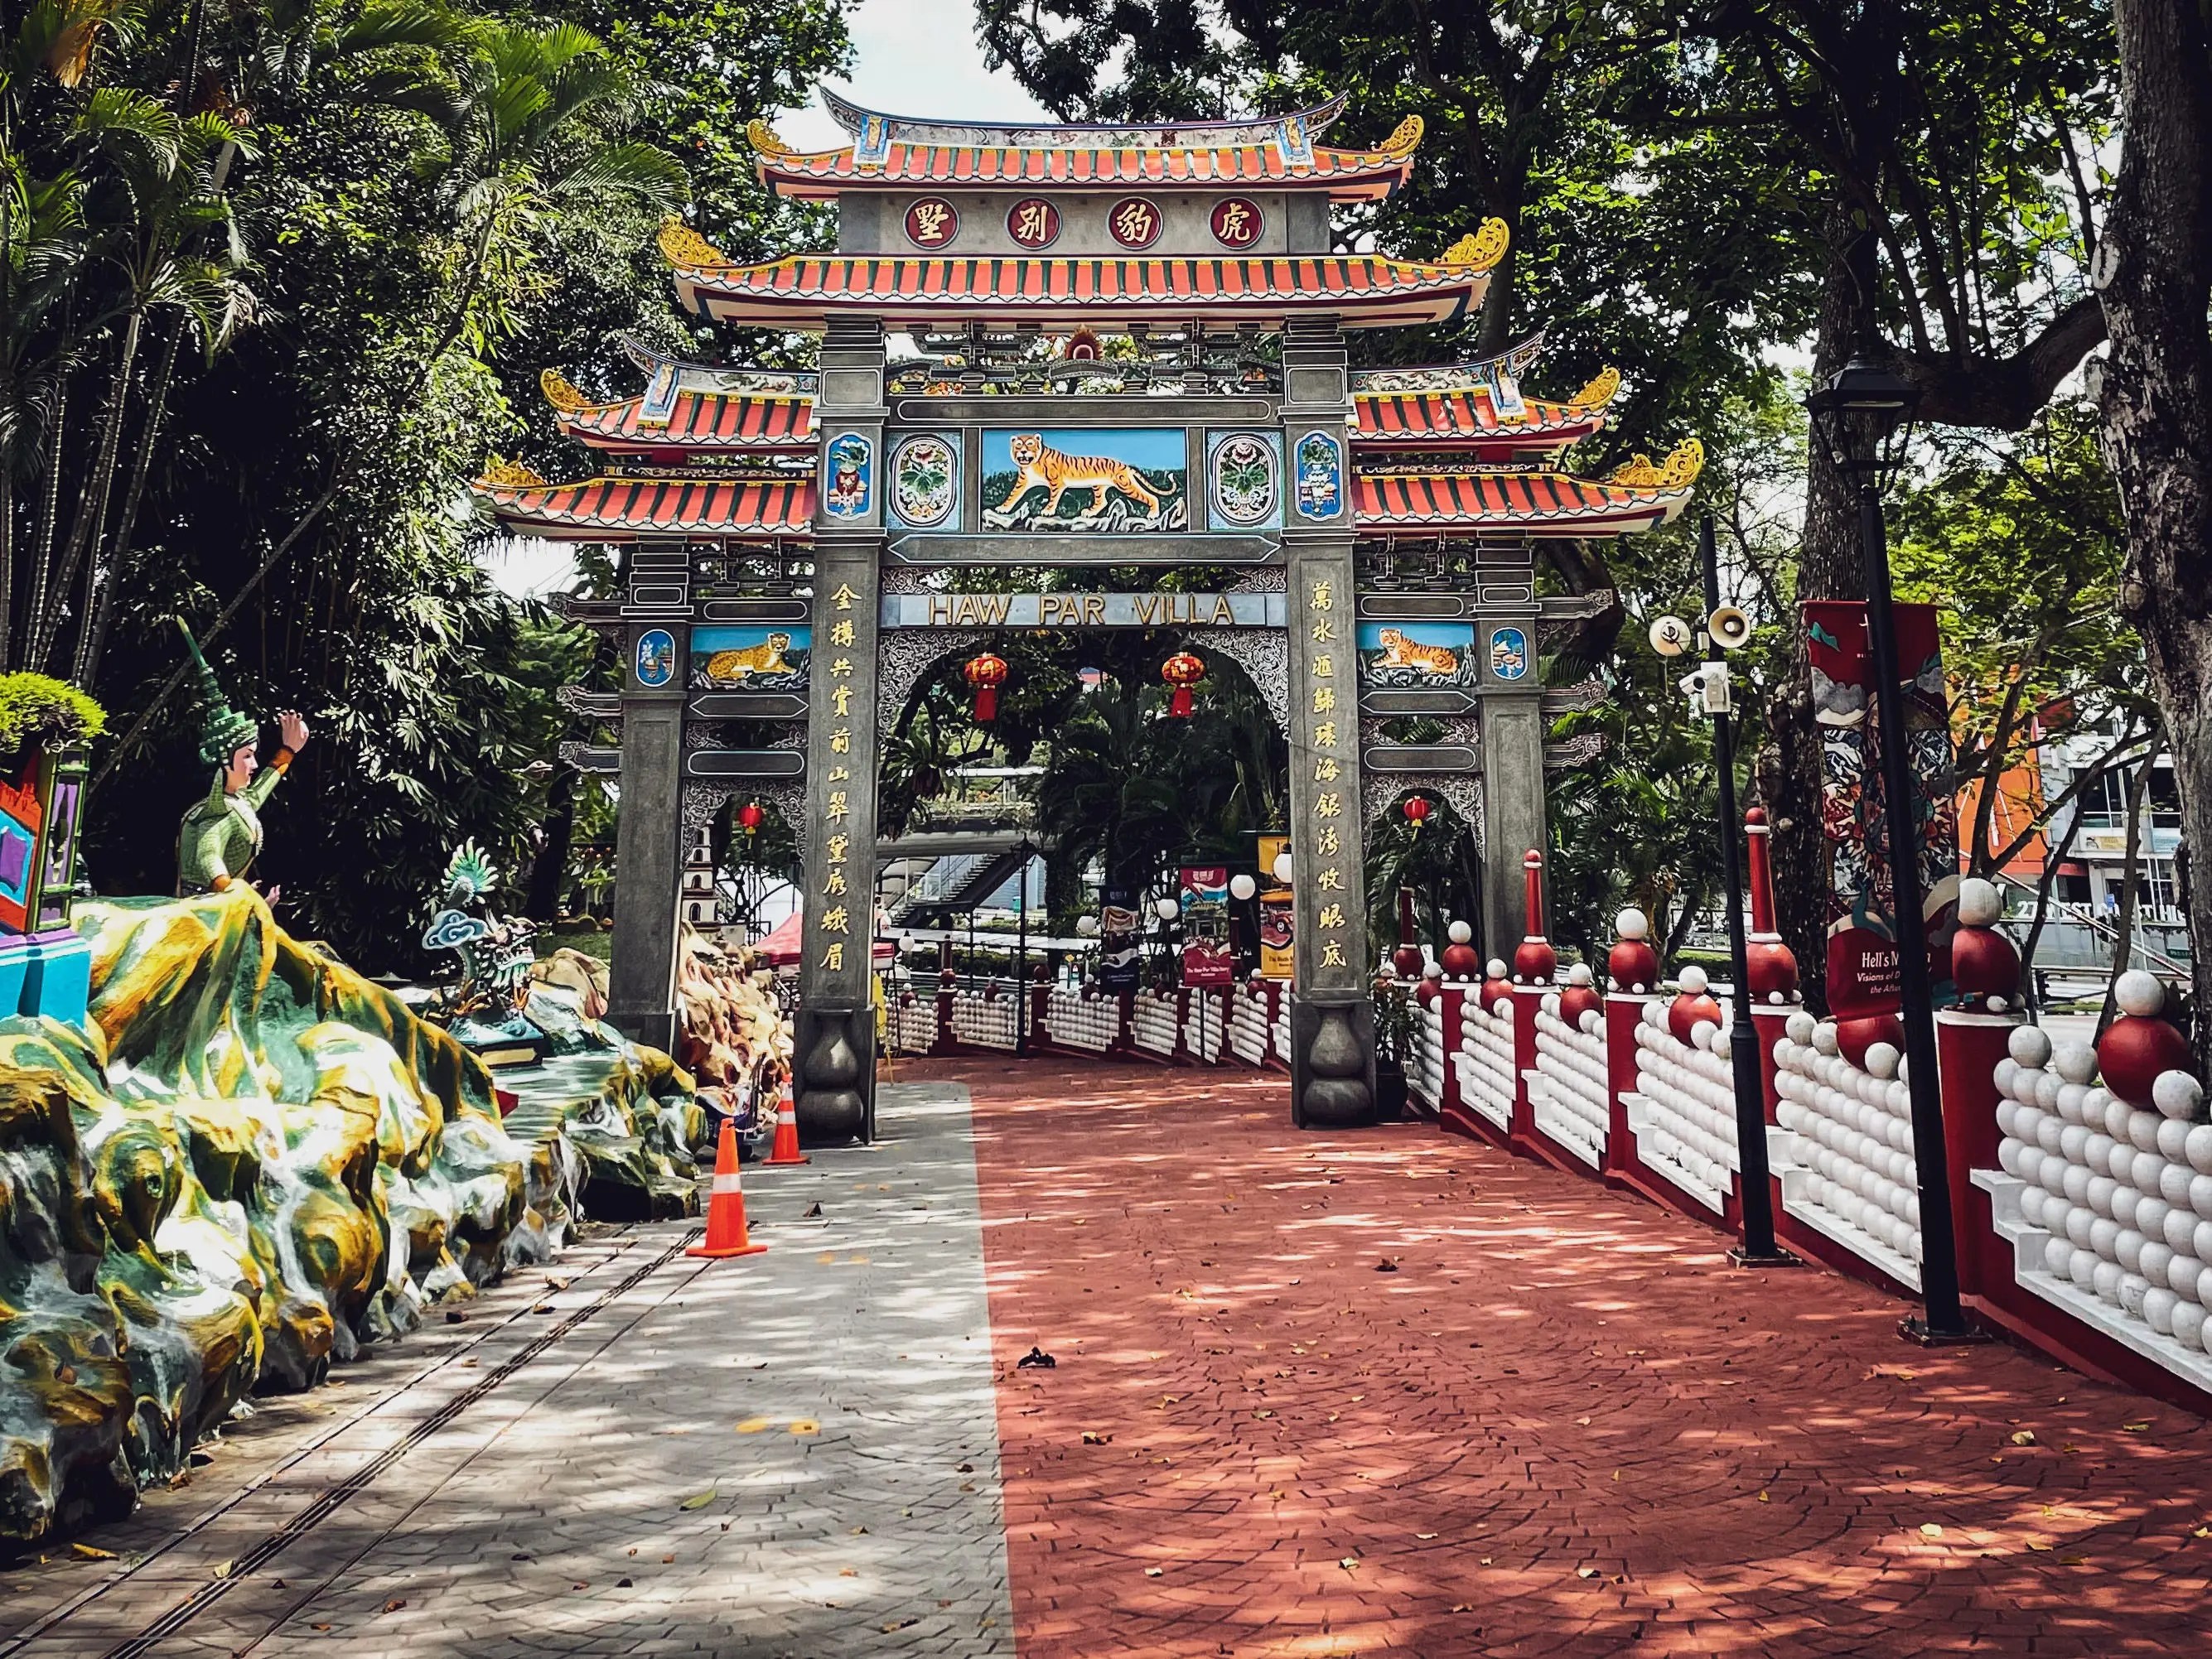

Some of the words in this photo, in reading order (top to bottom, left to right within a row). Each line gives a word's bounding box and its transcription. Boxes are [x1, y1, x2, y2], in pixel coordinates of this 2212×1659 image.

[928, 595, 1011, 625] HAW
[1038, 596, 1106, 625] PAR
[1133, 595, 1235, 625] VILLA
[2017, 900, 2039, 919] 27
[1862, 952, 1889, 968] Hell's
[1857, 972, 1884, 982] Visions
